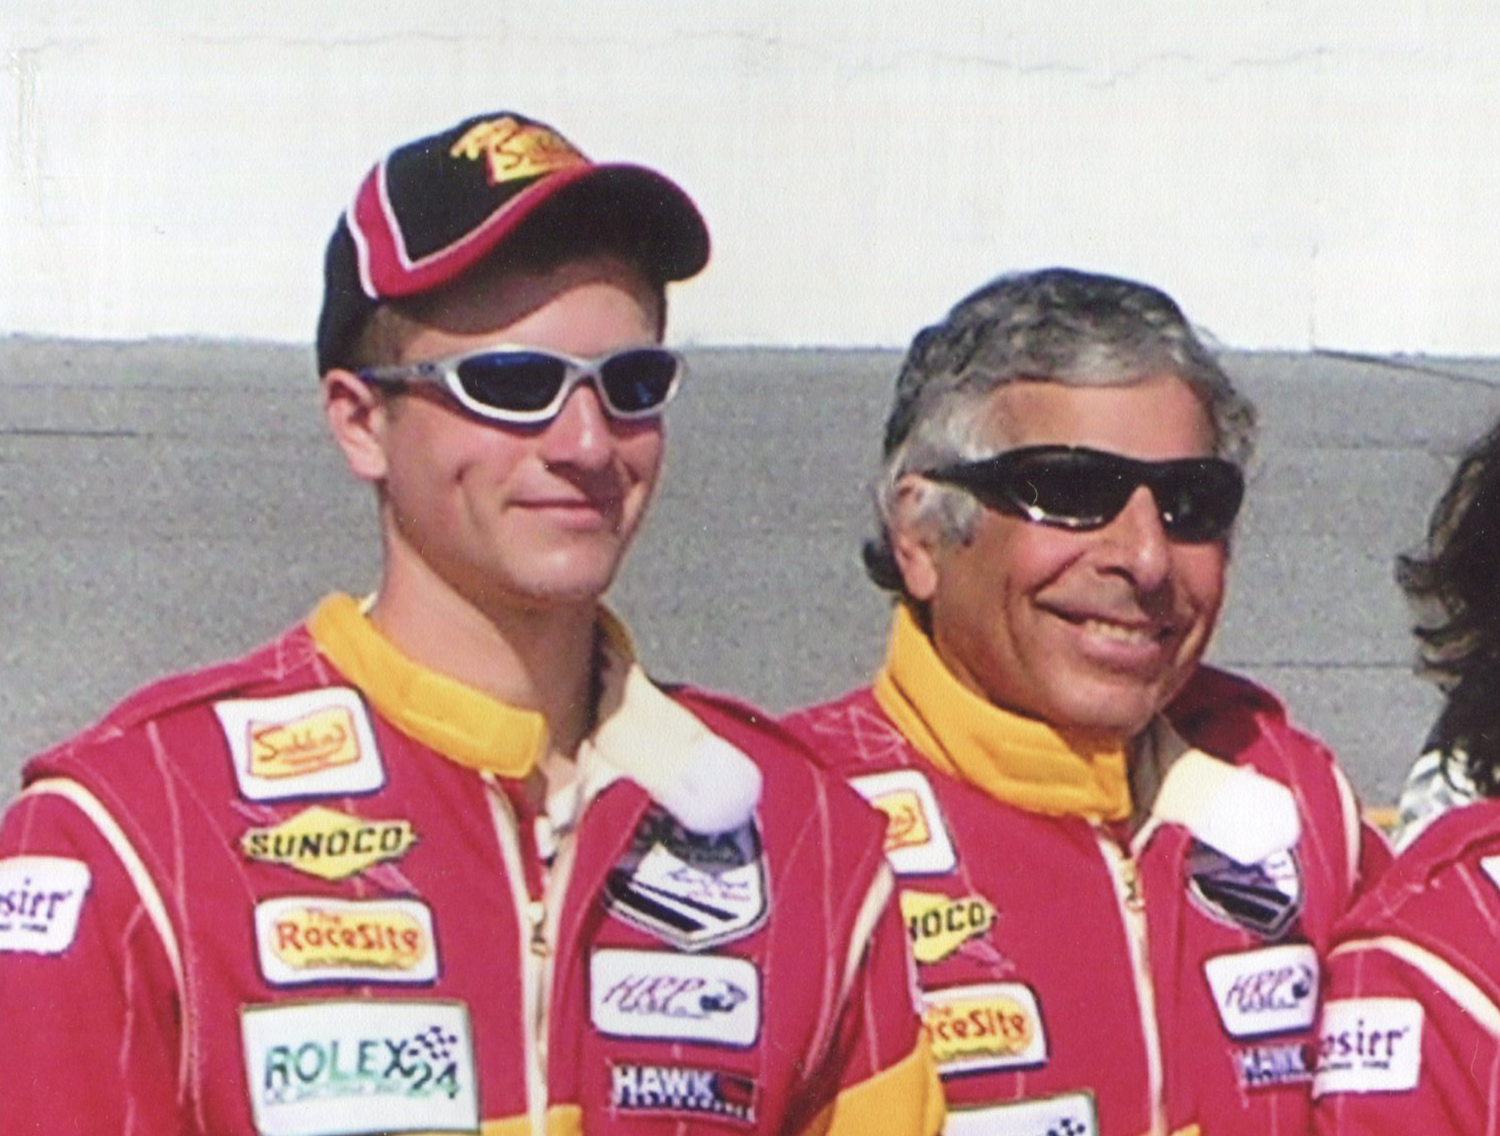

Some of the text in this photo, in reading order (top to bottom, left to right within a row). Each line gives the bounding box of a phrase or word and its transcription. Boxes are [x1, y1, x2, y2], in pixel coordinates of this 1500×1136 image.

[249, 824, 403, 859] SUNOCO
[276, 918, 420, 952] RaceSite
[264, 1038, 412, 1091] ROLEX
[404, 1060, 462, 1100] 24
[612, 1065, 717, 1107] HAWK
